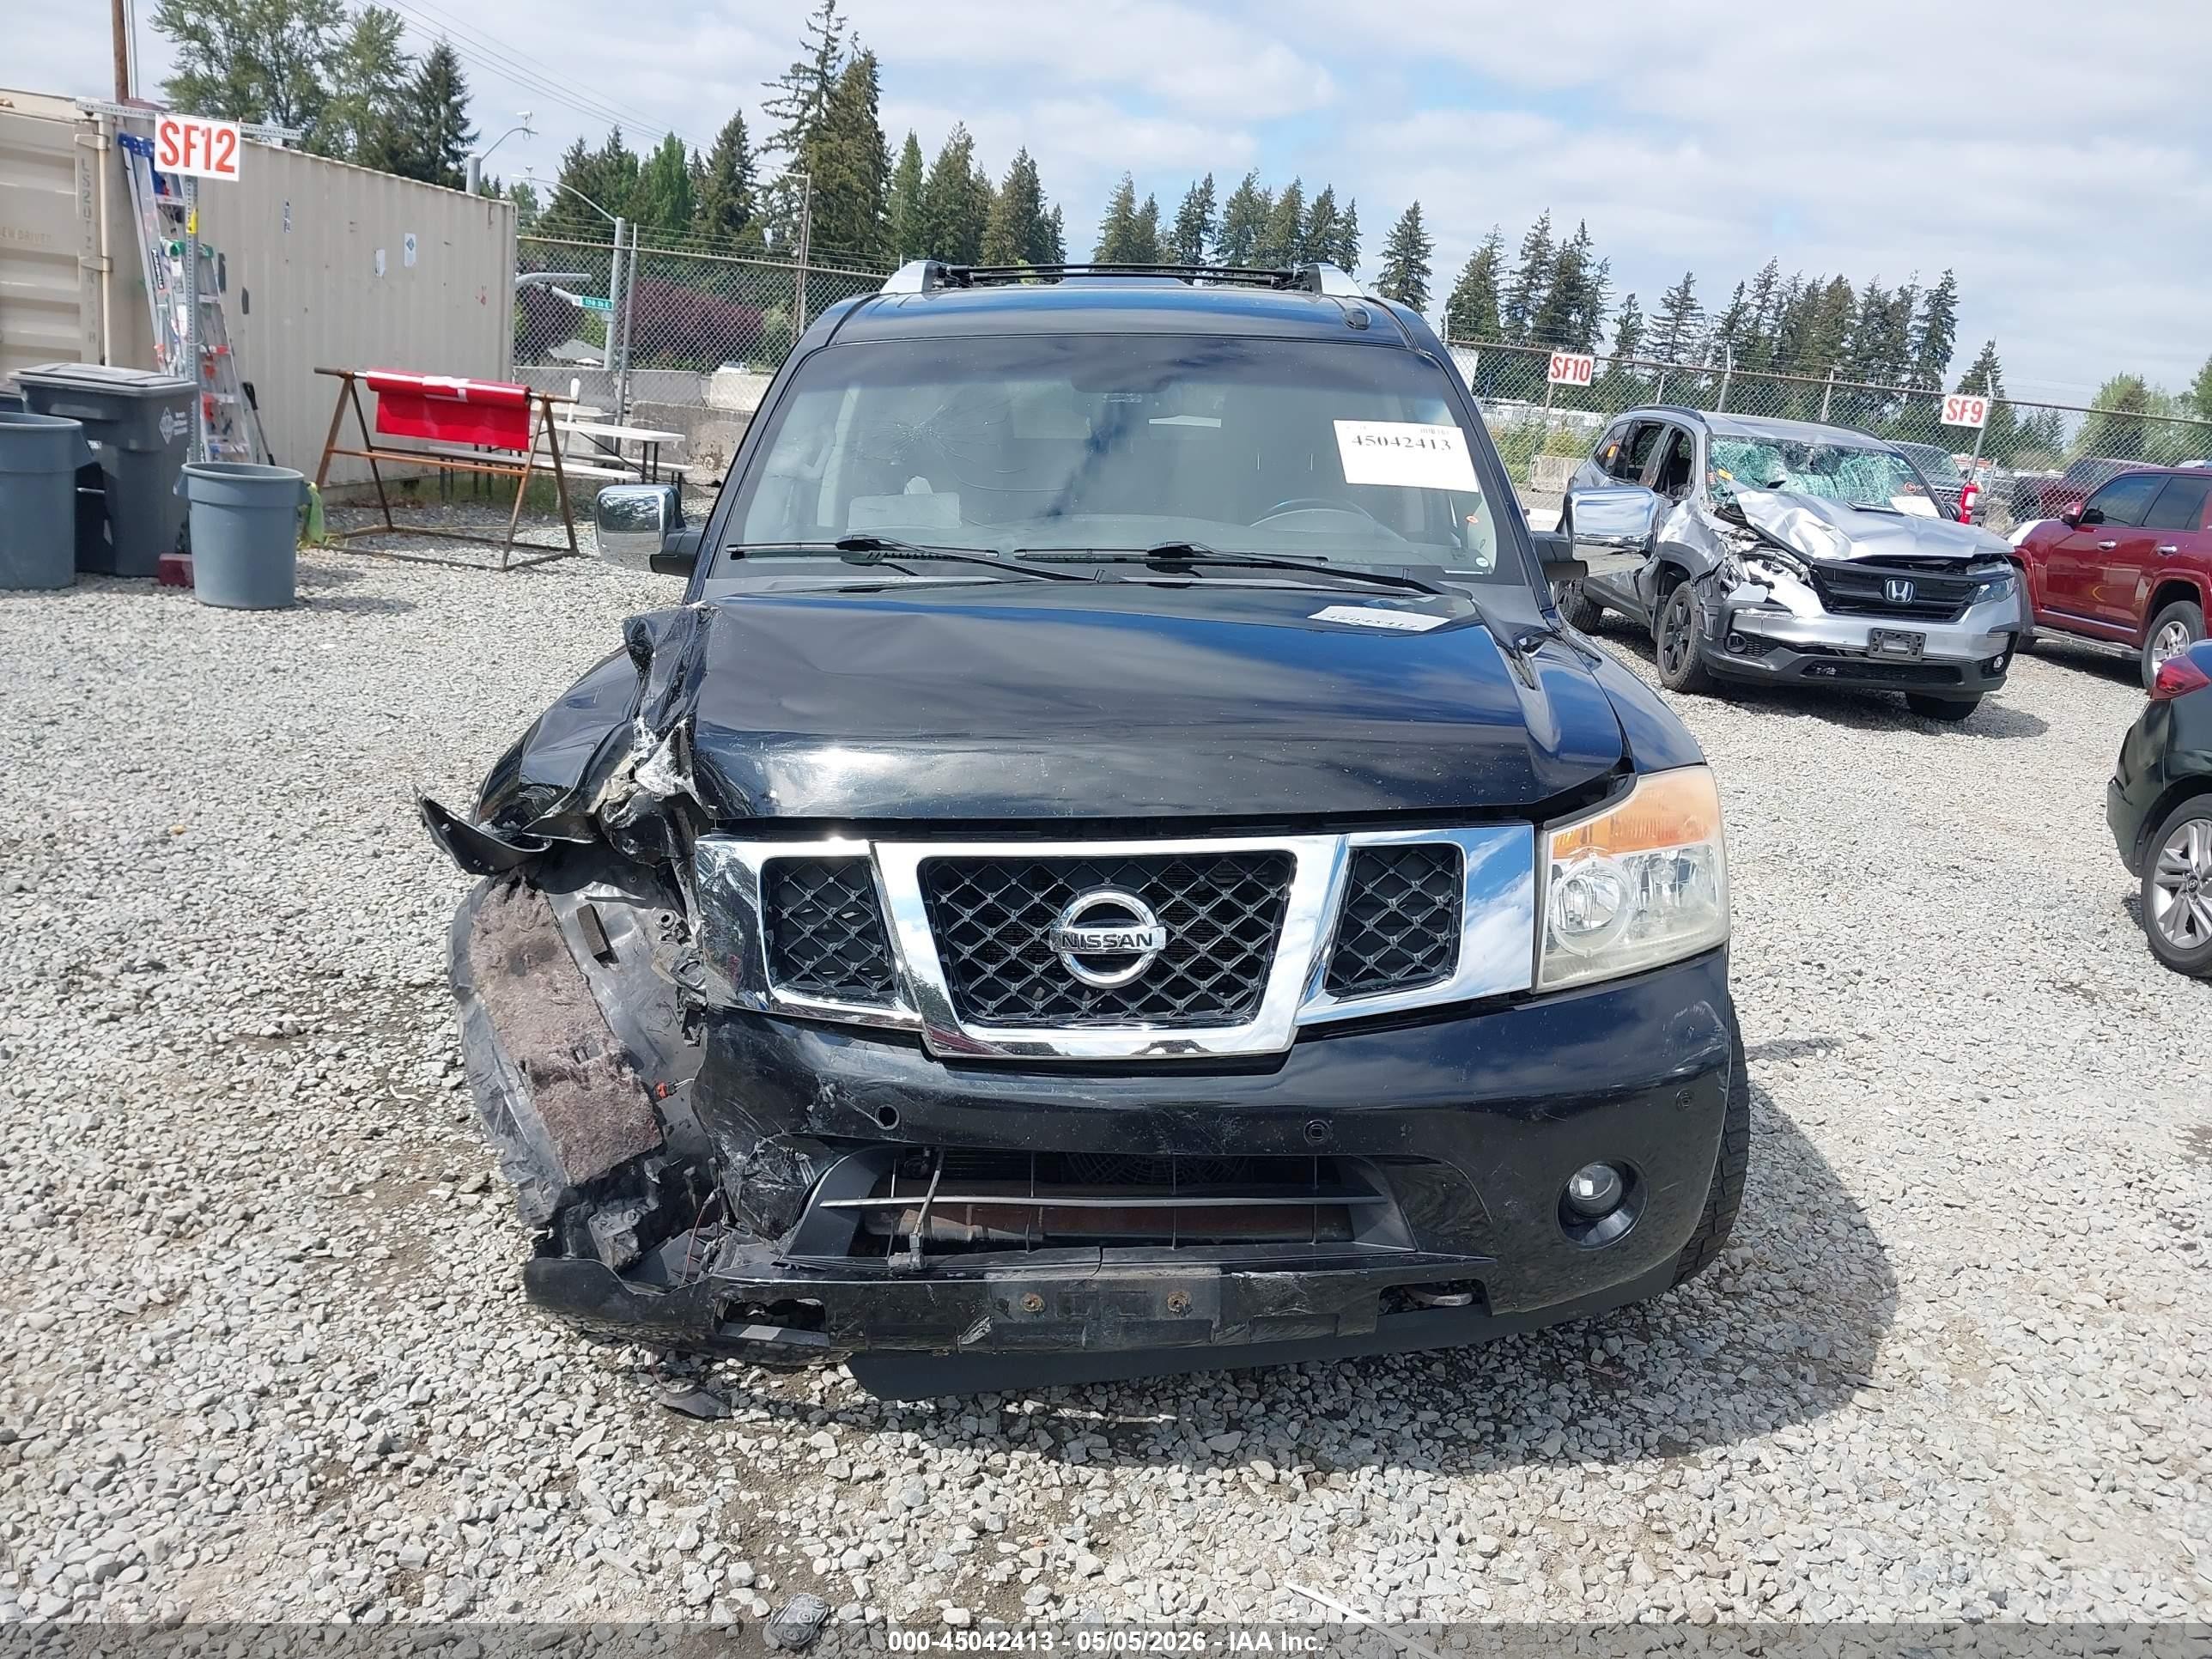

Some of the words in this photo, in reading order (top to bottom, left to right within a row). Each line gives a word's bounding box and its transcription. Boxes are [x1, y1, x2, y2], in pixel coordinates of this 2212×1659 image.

[160, 120, 236, 173] SF12
[1551, 356, 1591, 382] SF10
[1946, 398, 1984, 423] SF9
[1352, 434, 1451, 451] 45042413
[1061, 933, 1152, 949] NISSAN
